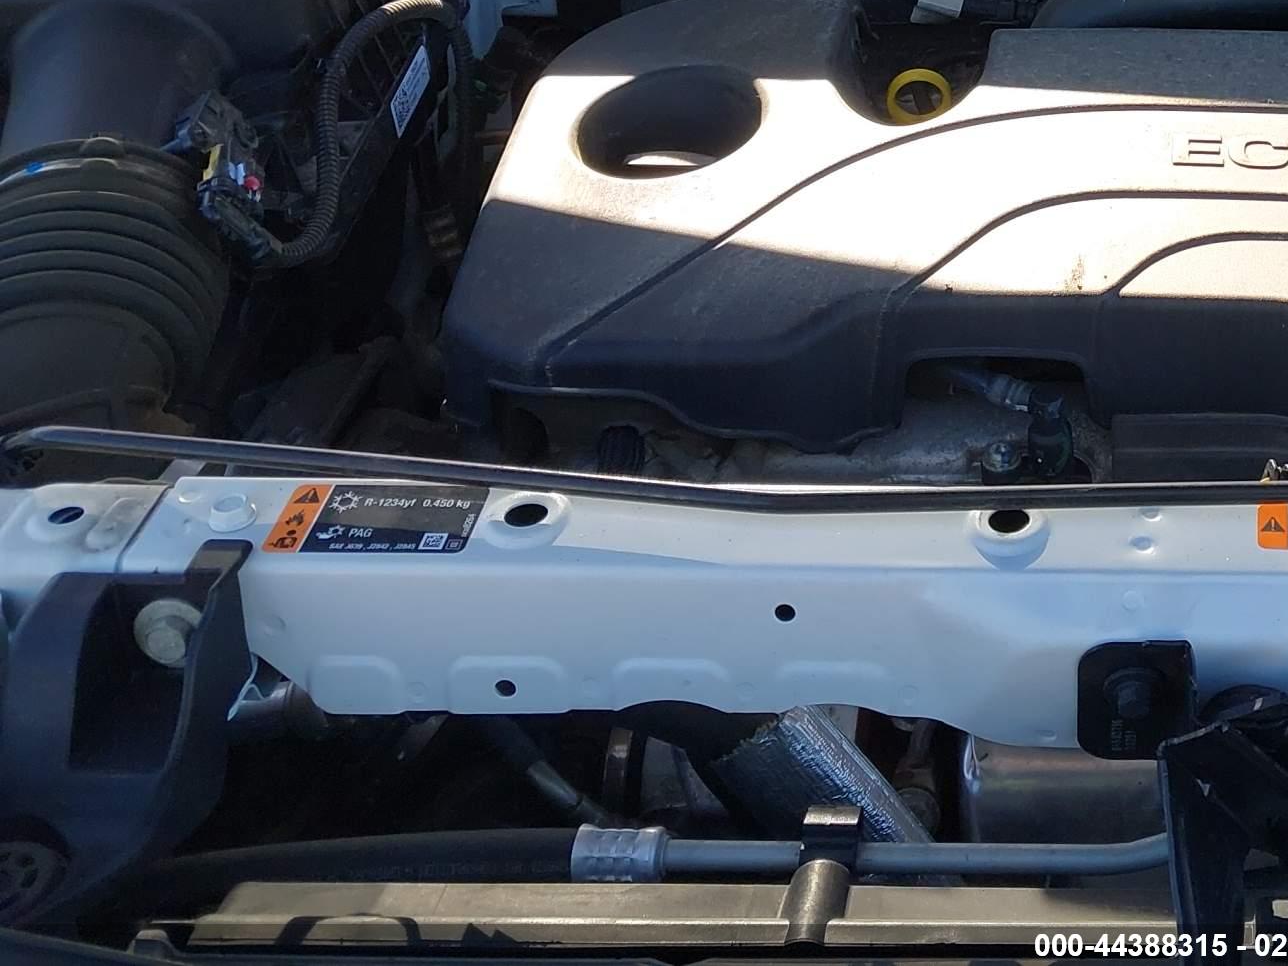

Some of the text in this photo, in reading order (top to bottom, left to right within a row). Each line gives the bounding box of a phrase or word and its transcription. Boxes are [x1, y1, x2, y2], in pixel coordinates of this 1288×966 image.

[363, 498, 471, 510] R-1234yf 0.450 kg
[348, 528, 374, 538] PAG
